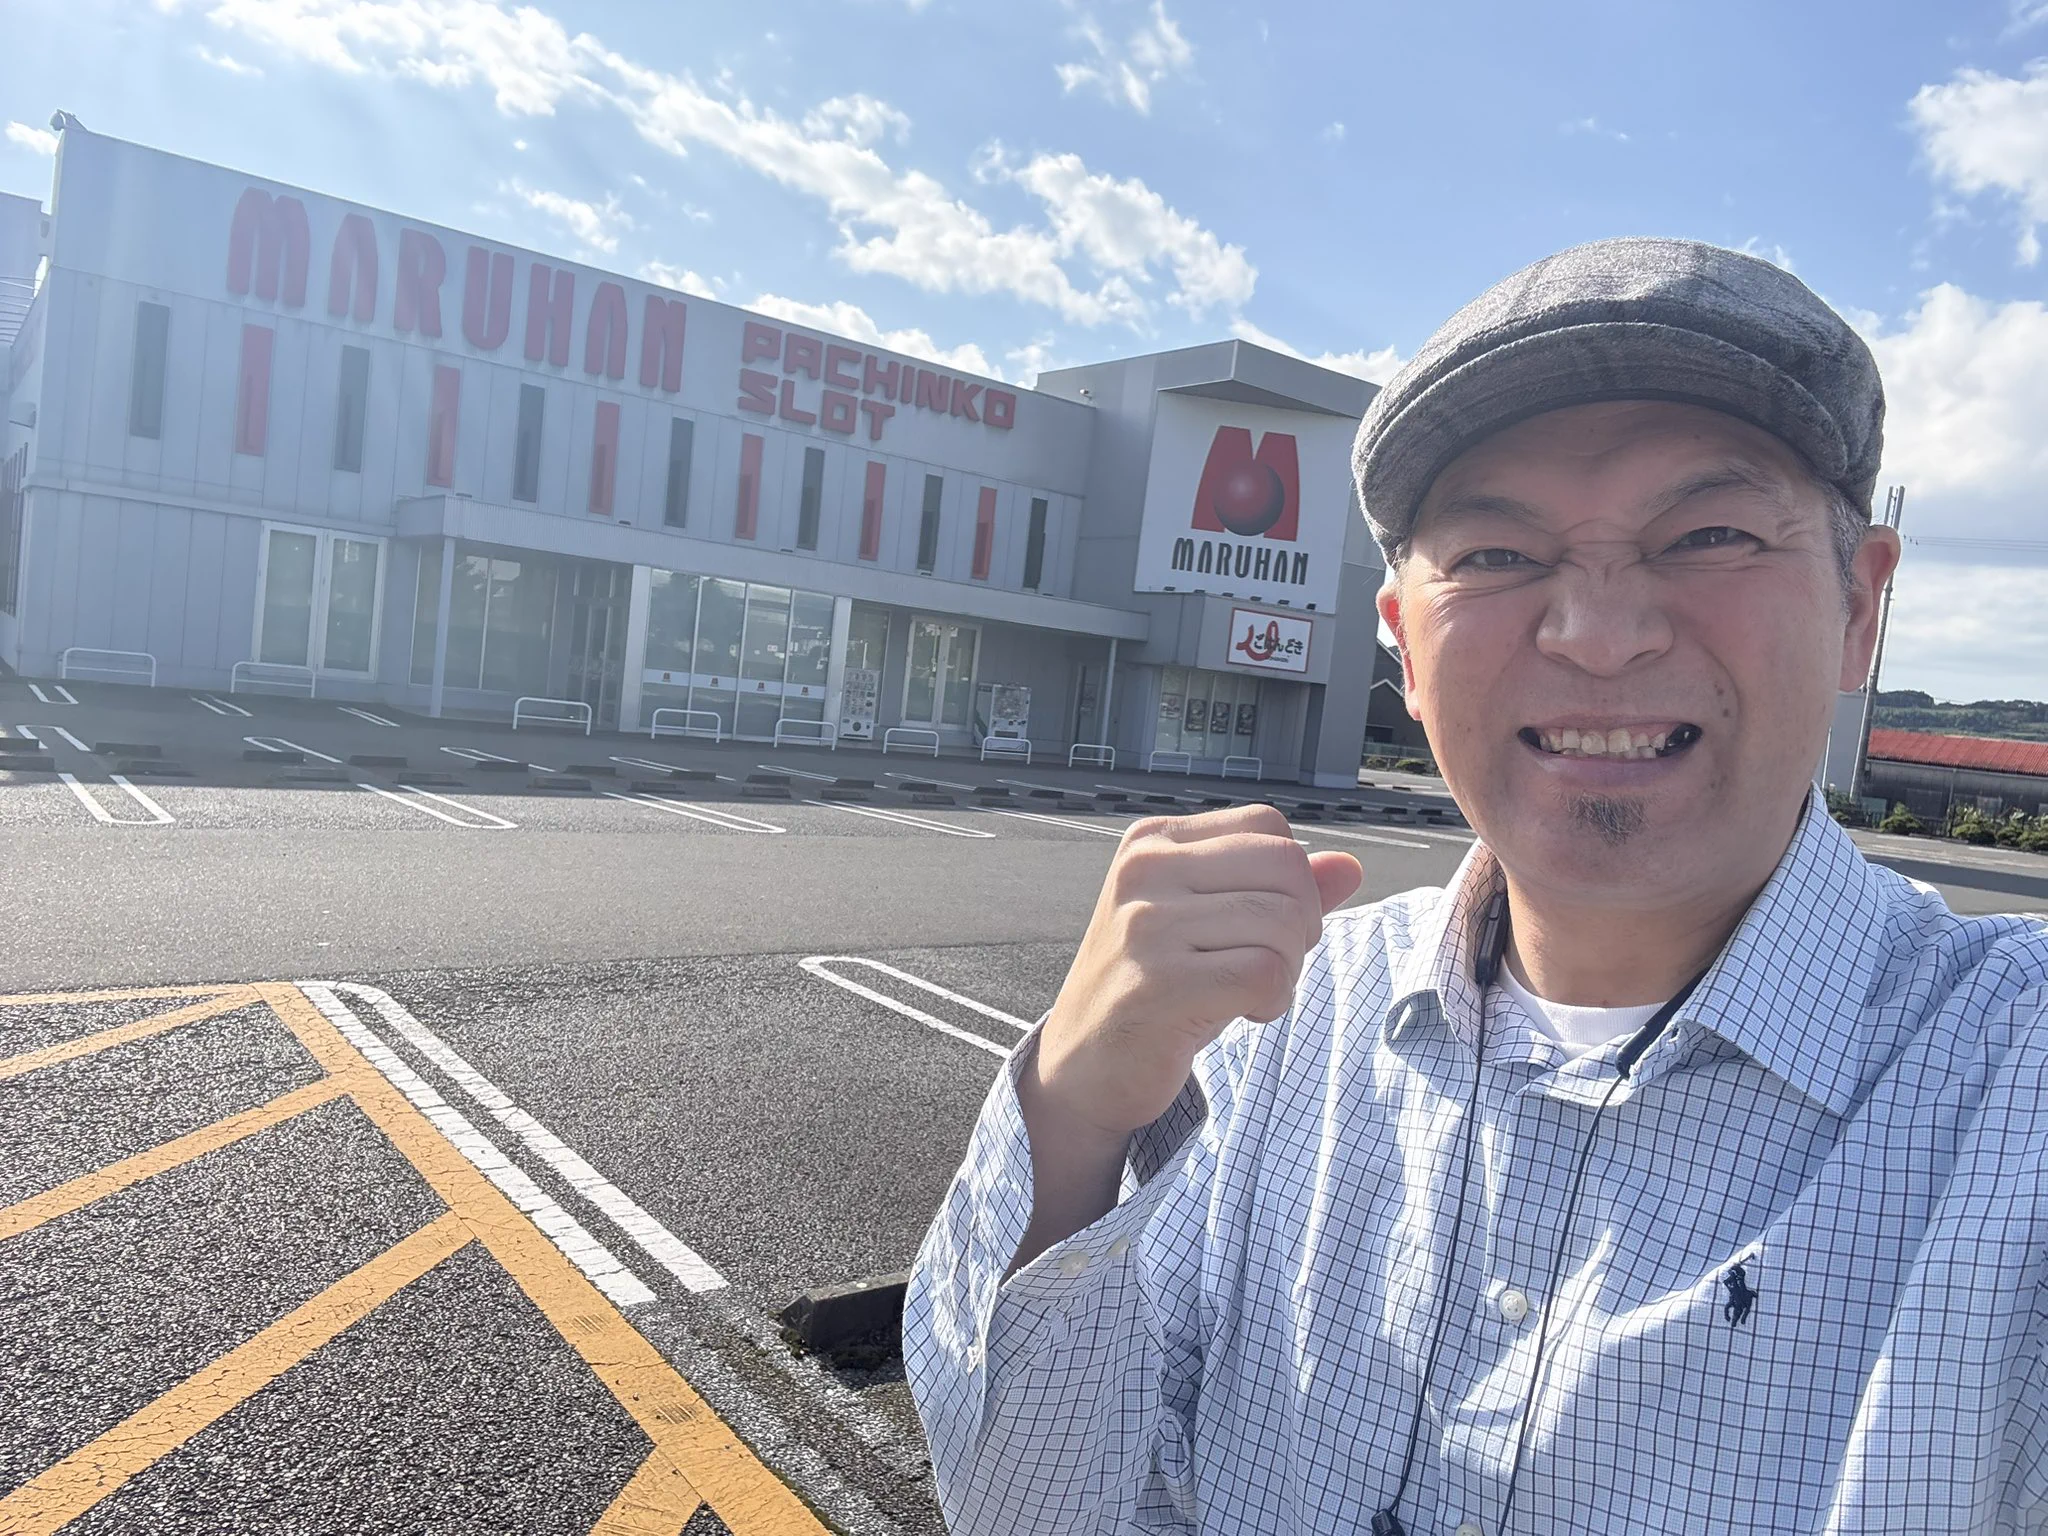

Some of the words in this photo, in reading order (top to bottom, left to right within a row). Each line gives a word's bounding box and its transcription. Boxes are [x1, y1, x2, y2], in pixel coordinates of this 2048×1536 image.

[226, 186, 687, 393] MARUHAN
[738, 368, 895, 440] SLOT
[742, 321, 1016, 429] PACHINKO
[1171, 537, 1309, 585] MARUHAN
